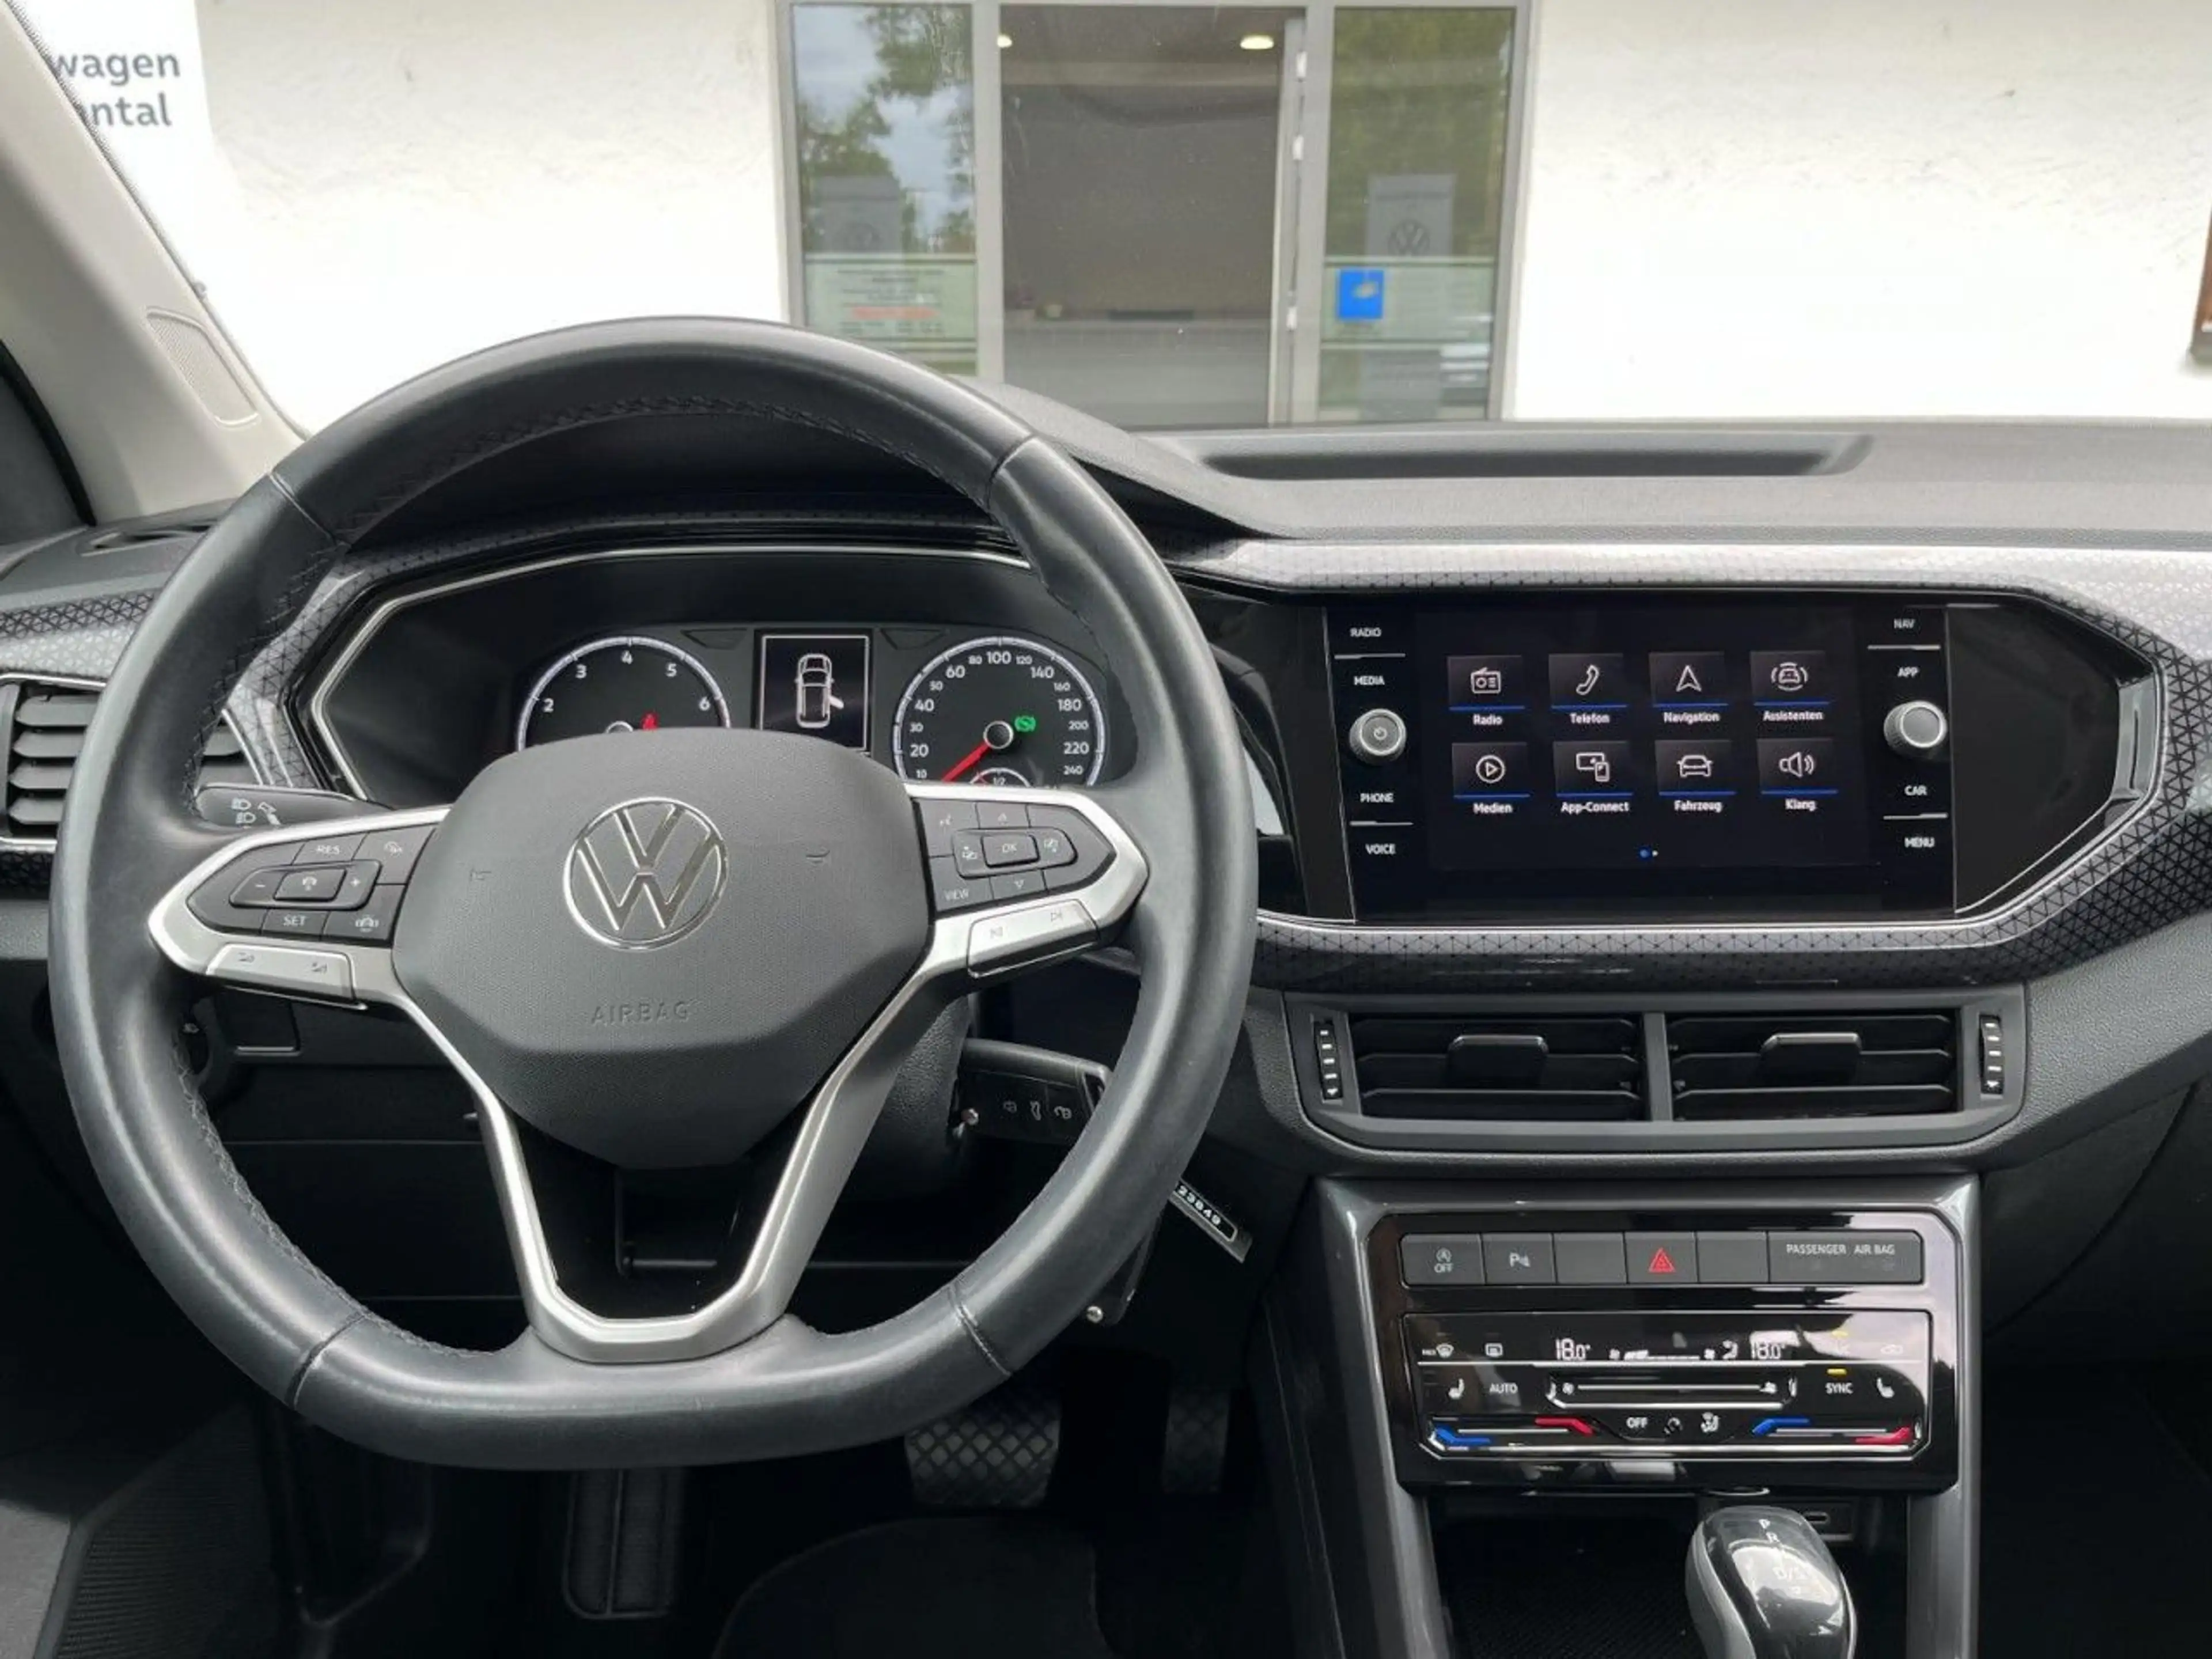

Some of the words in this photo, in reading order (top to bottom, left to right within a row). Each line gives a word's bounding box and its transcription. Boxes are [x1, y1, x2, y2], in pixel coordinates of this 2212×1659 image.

[58, 54, 180, 86] wagen
[82, 91, 172, 126] ntal
[1893, 619, 1915, 630] NAV
[1350, 627, 1382, 637] RADIO
[622, 650, 632, 664] 4
[969, 656, 982, 664] 80
[987, 652, 1011, 665] 100
[1016, 656, 1032, 664] 120
[576, 664, 587, 679] 3
[666, 663, 677, 677] 5
[946, 666, 965, 678] 60
[1031, 666, 1055, 679] 140
[1897, 667, 1919, 678] APP
[930, 681, 943, 691] 50
[1054, 682, 1070, 691] 160
[1354, 676, 1385, 686] MEDIA
[543, 698, 554, 713] 2
[699, 696, 711, 711] 6
[915, 699, 934, 711] 40
[1058, 699, 1082, 711] 180
[1473, 714, 1503, 725] Radio
[1570, 712, 1611, 724] Telefon
[1664, 710, 1720, 725] Navigation
[1763, 709, 1823, 721] Assistenten
[910, 724, 923, 733] 30
[1069, 721, 1089, 730] 200
[910, 744, 929, 757] 20
[1063, 742, 1089, 754] 220
[916, 770, 927, 779] 10
[1064, 765, 1083, 775] 240
[1904, 785, 1927, 797] CAR
[1360, 793, 1394, 804] PHONE
[1473, 803, 1513, 815] Medien
[1560, 801, 1630, 815] App-Connect
[1674, 799, 1722, 813] Fahrzeug
[1785, 798, 1816, 812] Klang
[316, 844, 339, 855] RES
[1002, 843, 1017, 853] OK
[1365, 844, 1396, 855] VOICE
[1904, 838, 1934, 849] MENU
[944, 889, 969, 901] VIEW
[283, 915, 307, 927] SET
[591, 1001, 691, 1025] AIRBAG
[1786, 1244, 1847, 1255] PASSENGER
[1854, 1244, 1872, 1255] AIR
[1874, 1244, 1895, 1255] BAG
[1434, 1263, 1453, 1273] OFF
[1489, 1383, 1518, 1394] AUTO
[1825, 1382, 1853, 1394] SYNC
[1626, 1416, 1648, 1429] OFF
